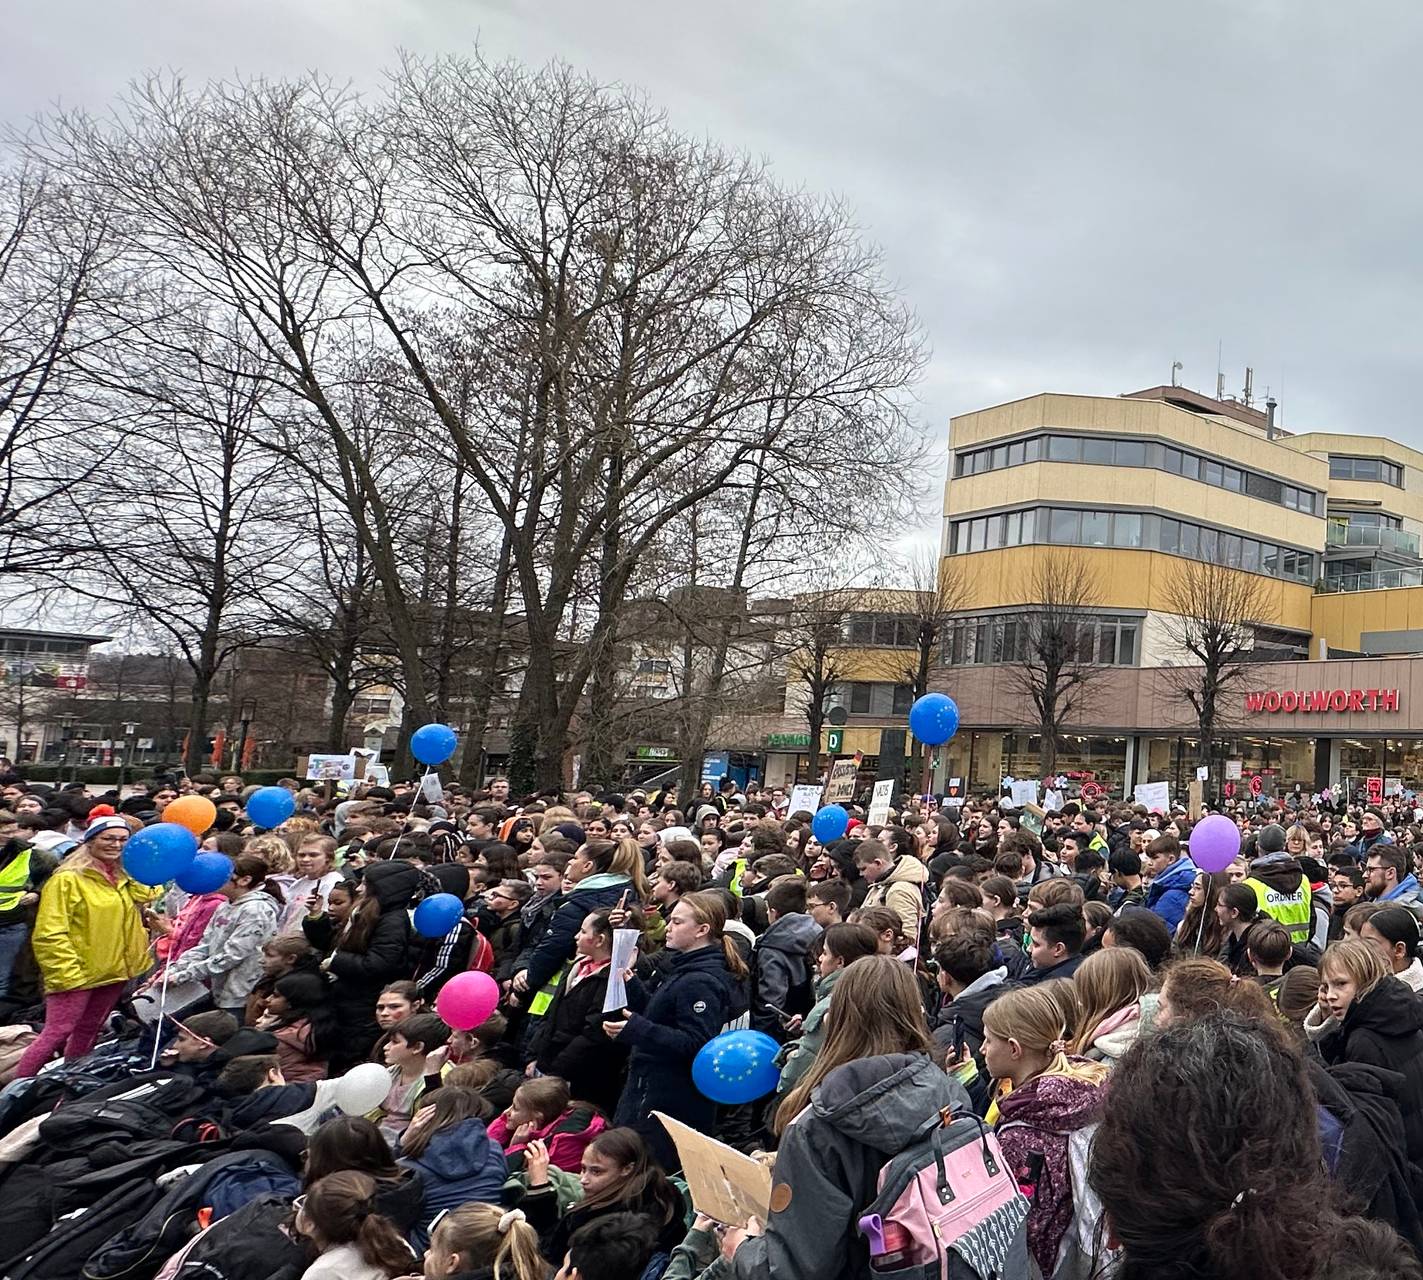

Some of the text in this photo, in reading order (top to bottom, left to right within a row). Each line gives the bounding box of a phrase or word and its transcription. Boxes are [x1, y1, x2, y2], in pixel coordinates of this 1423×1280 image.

[1245, 689, 1400, 712] WOOLWORTH
[829, 734, 838, 748] D
[1266, 891, 1303, 903] ORDNER
